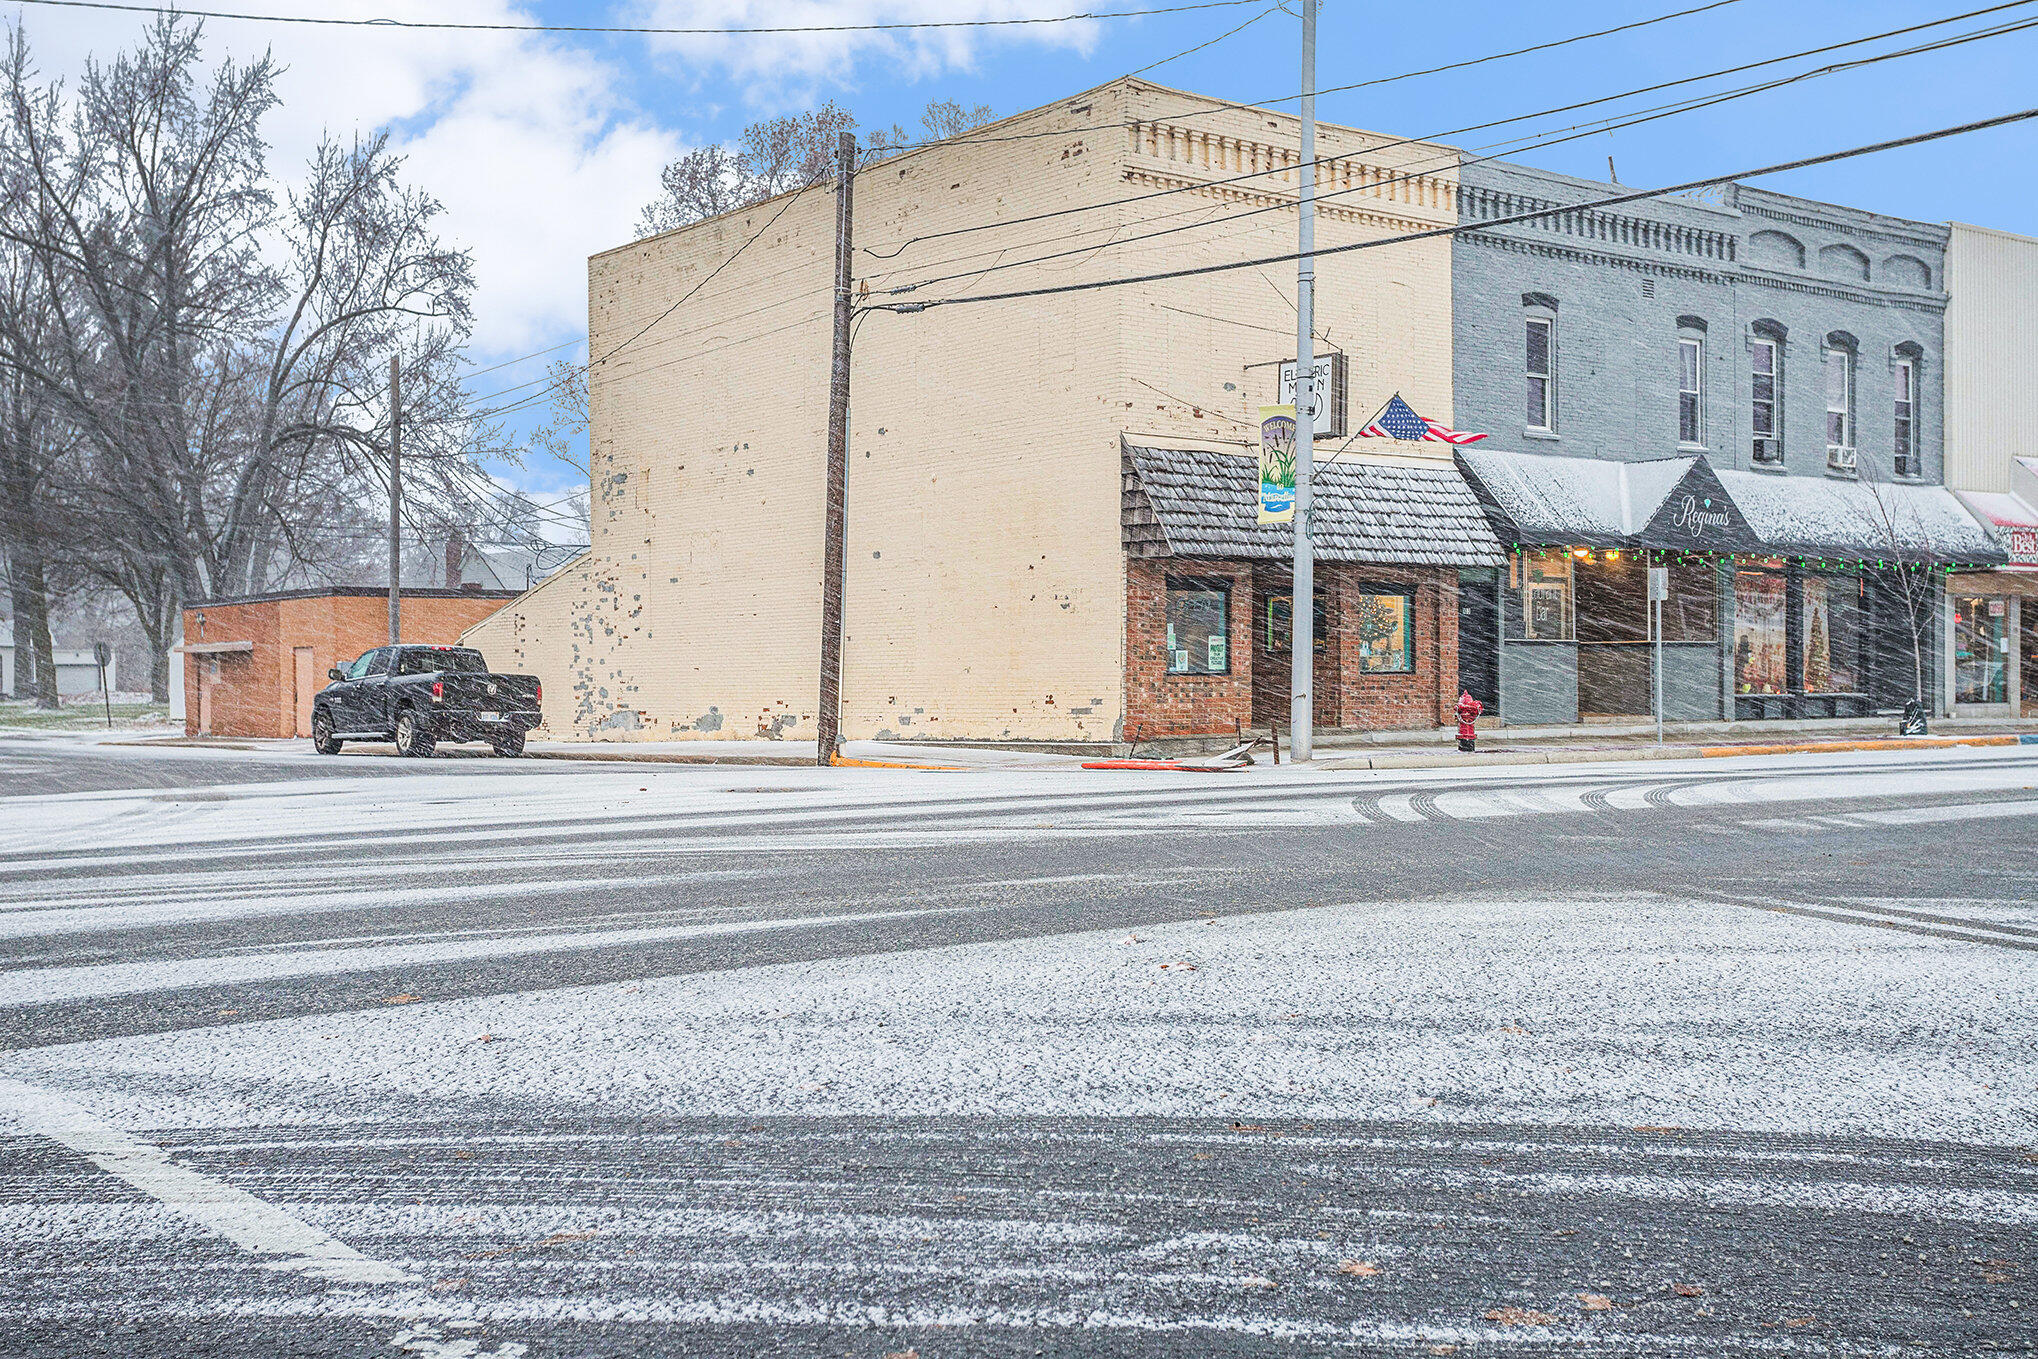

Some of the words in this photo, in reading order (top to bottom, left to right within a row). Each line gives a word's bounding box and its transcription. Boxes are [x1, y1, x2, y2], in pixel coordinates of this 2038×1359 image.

[1284, 363, 1330, 382] ELRIC
[1288, 378, 1325, 394] MN
[1263, 420, 1296, 432] WELCOME
[1673, 494, 1731, 537] Regina's
[2013, 534, 2036, 553] Best
